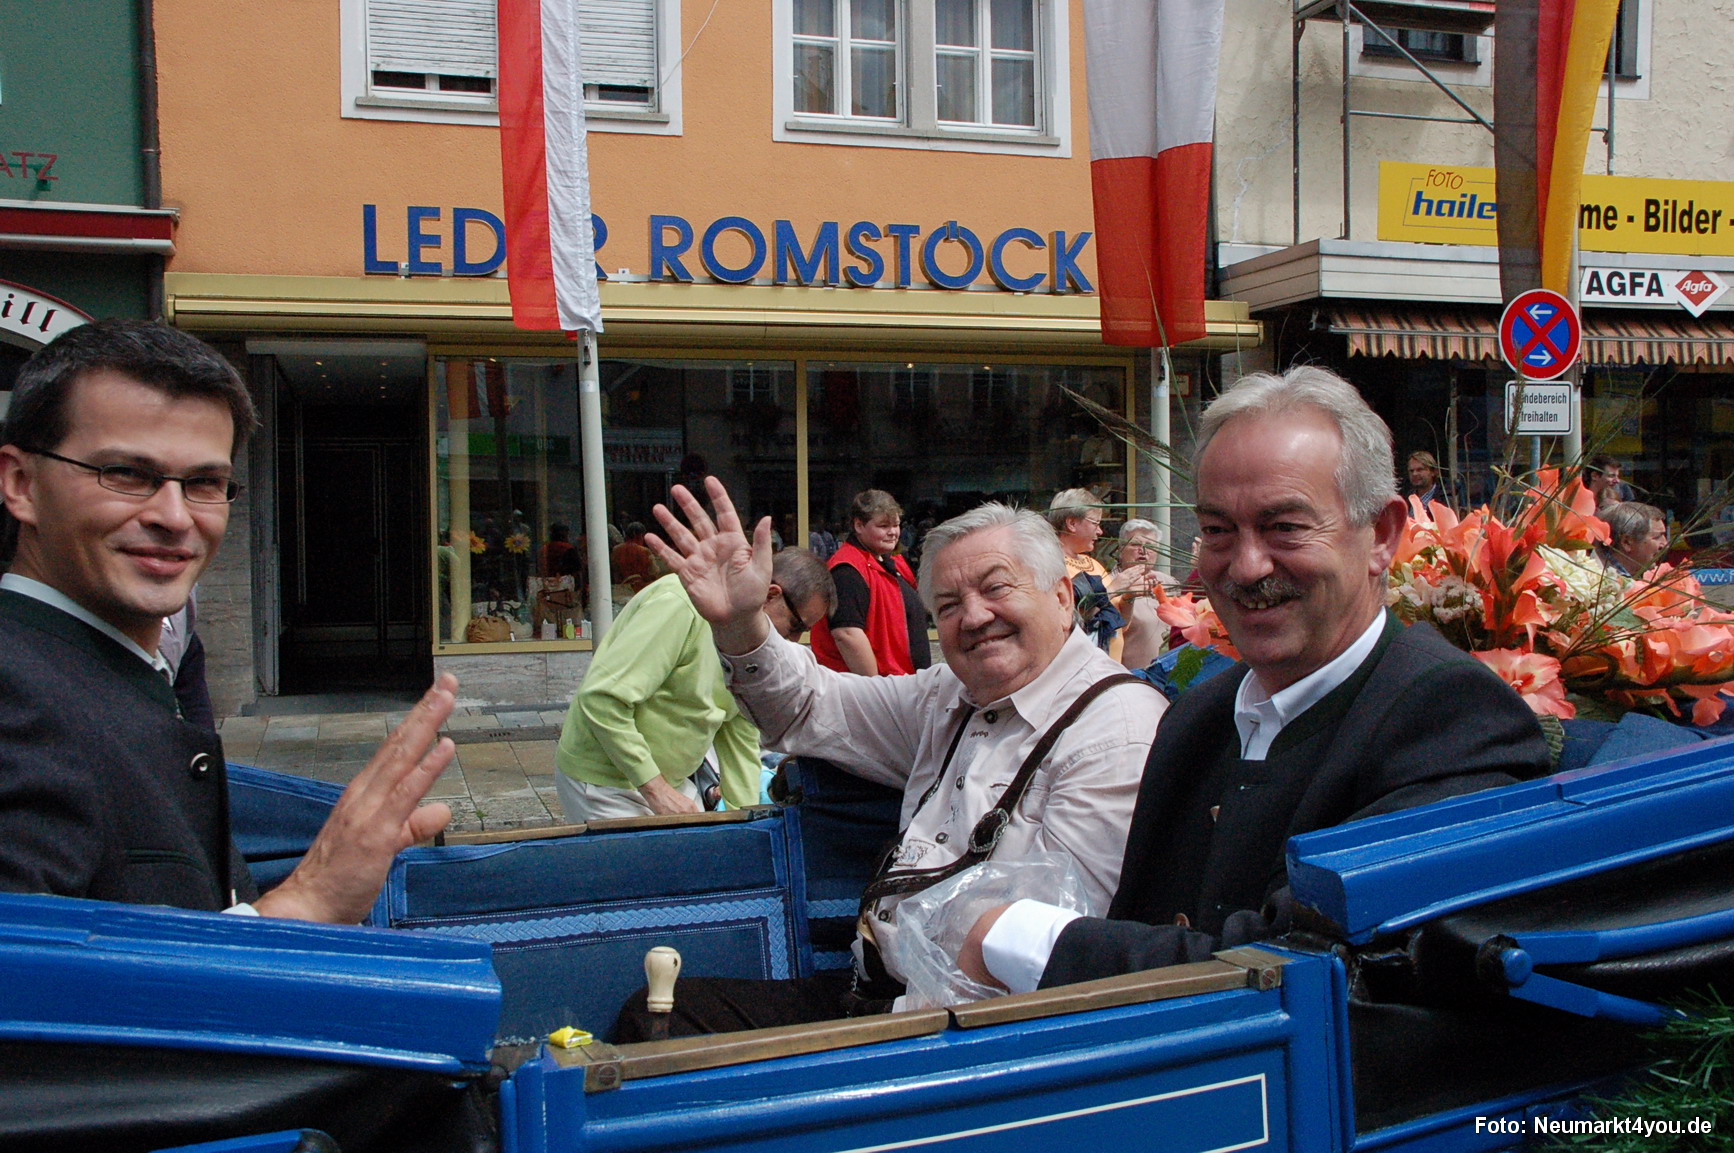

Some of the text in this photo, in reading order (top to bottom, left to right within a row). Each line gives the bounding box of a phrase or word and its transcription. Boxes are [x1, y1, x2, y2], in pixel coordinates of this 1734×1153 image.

[1426, 169, 1463, 189] FOTO
[1644, 198, 1722, 234] Bilder
[1585, 270, 1664, 297] AGFA
[1680, 279, 1712, 295] Agfa
